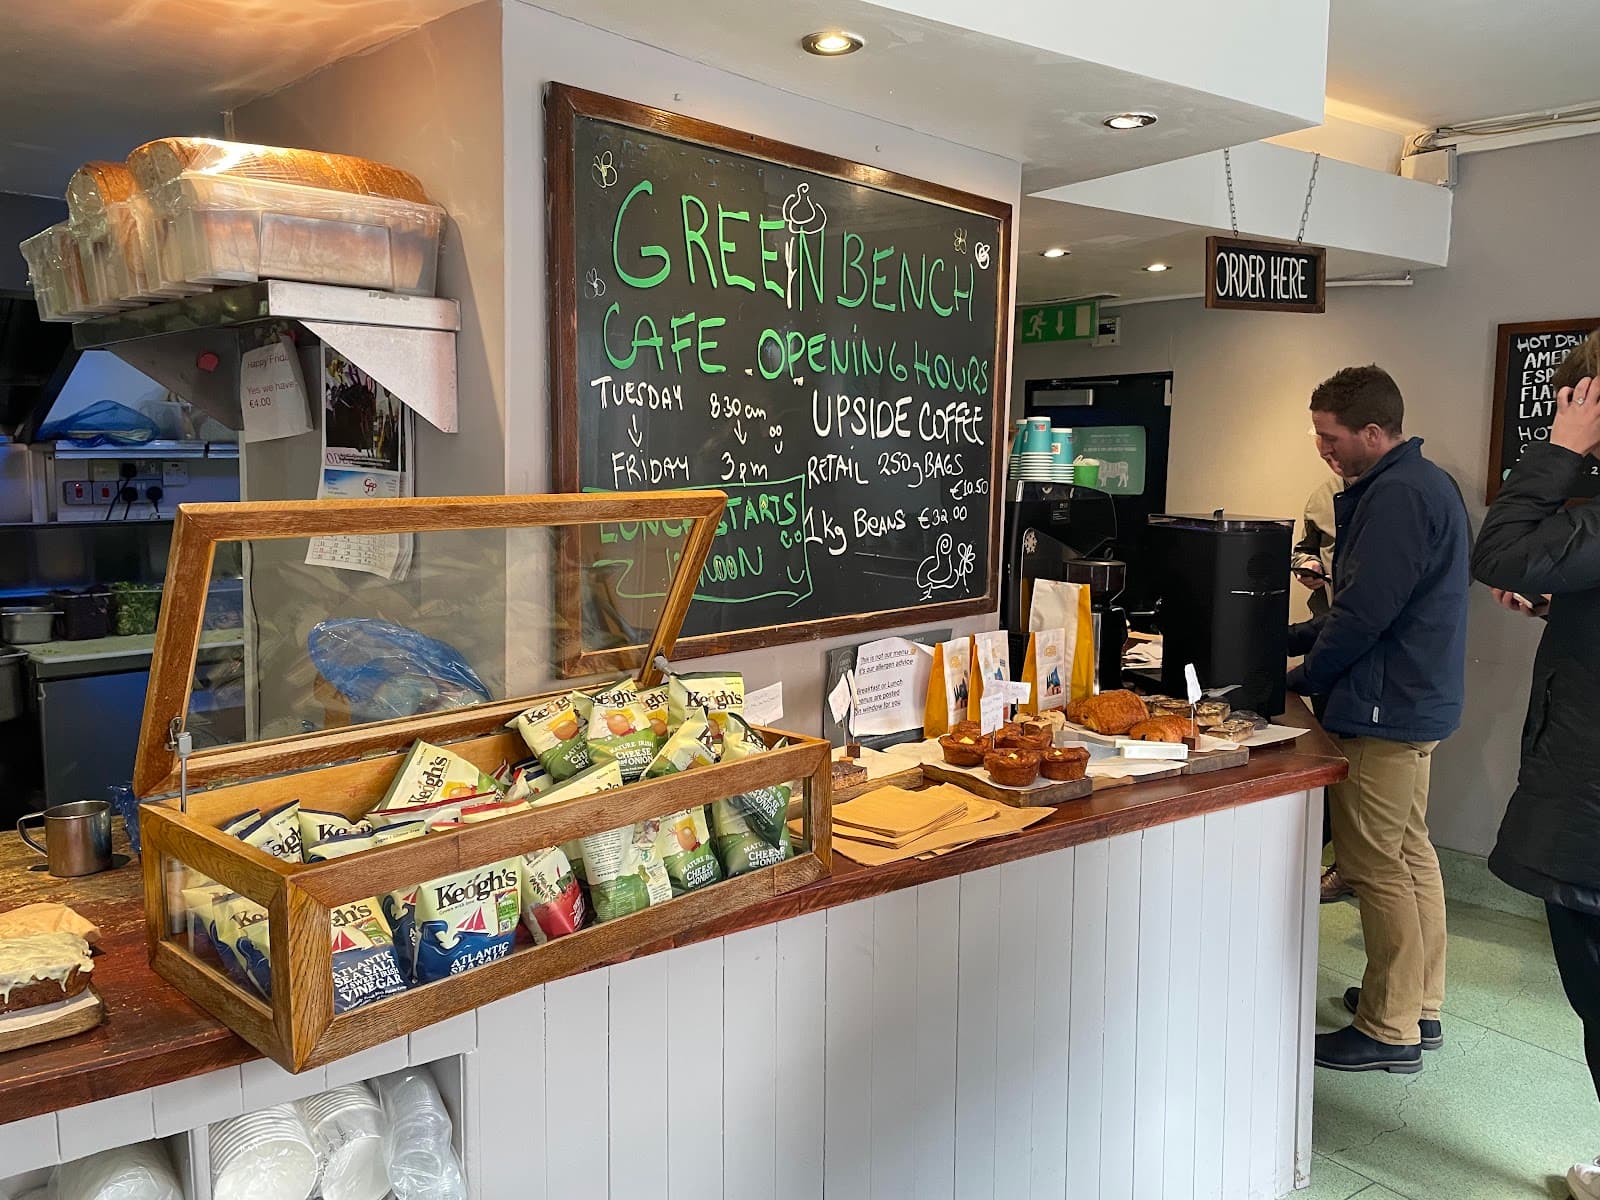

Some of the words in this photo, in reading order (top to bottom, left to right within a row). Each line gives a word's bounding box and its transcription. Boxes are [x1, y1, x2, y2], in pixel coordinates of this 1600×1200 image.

[612, 179, 826, 311] GREEN
[836, 229, 975, 322] BENCH
[1216, 252, 1265, 299] ORDER
[1270, 255, 1308, 300] HERE
[603, 301, 727, 374] CAFE
[914, 340, 989, 395] HOURS
[1517, 334, 1551, 352] HOT
[812, 389, 913, 440] UPSIDE
[918, 401, 985, 446] COFFEE
[877, 451, 924, 489] 250g
[924, 450, 964, 480] BAGS
[332, 950, 393, 980] ATLANTIC
[450, 941, 510, 968] ATLANTIC
[340, 974, 404, 1002] VINEGAR
[349, 973, 380, 989] SWEET
[379, 967, 400, 978] IRISH
